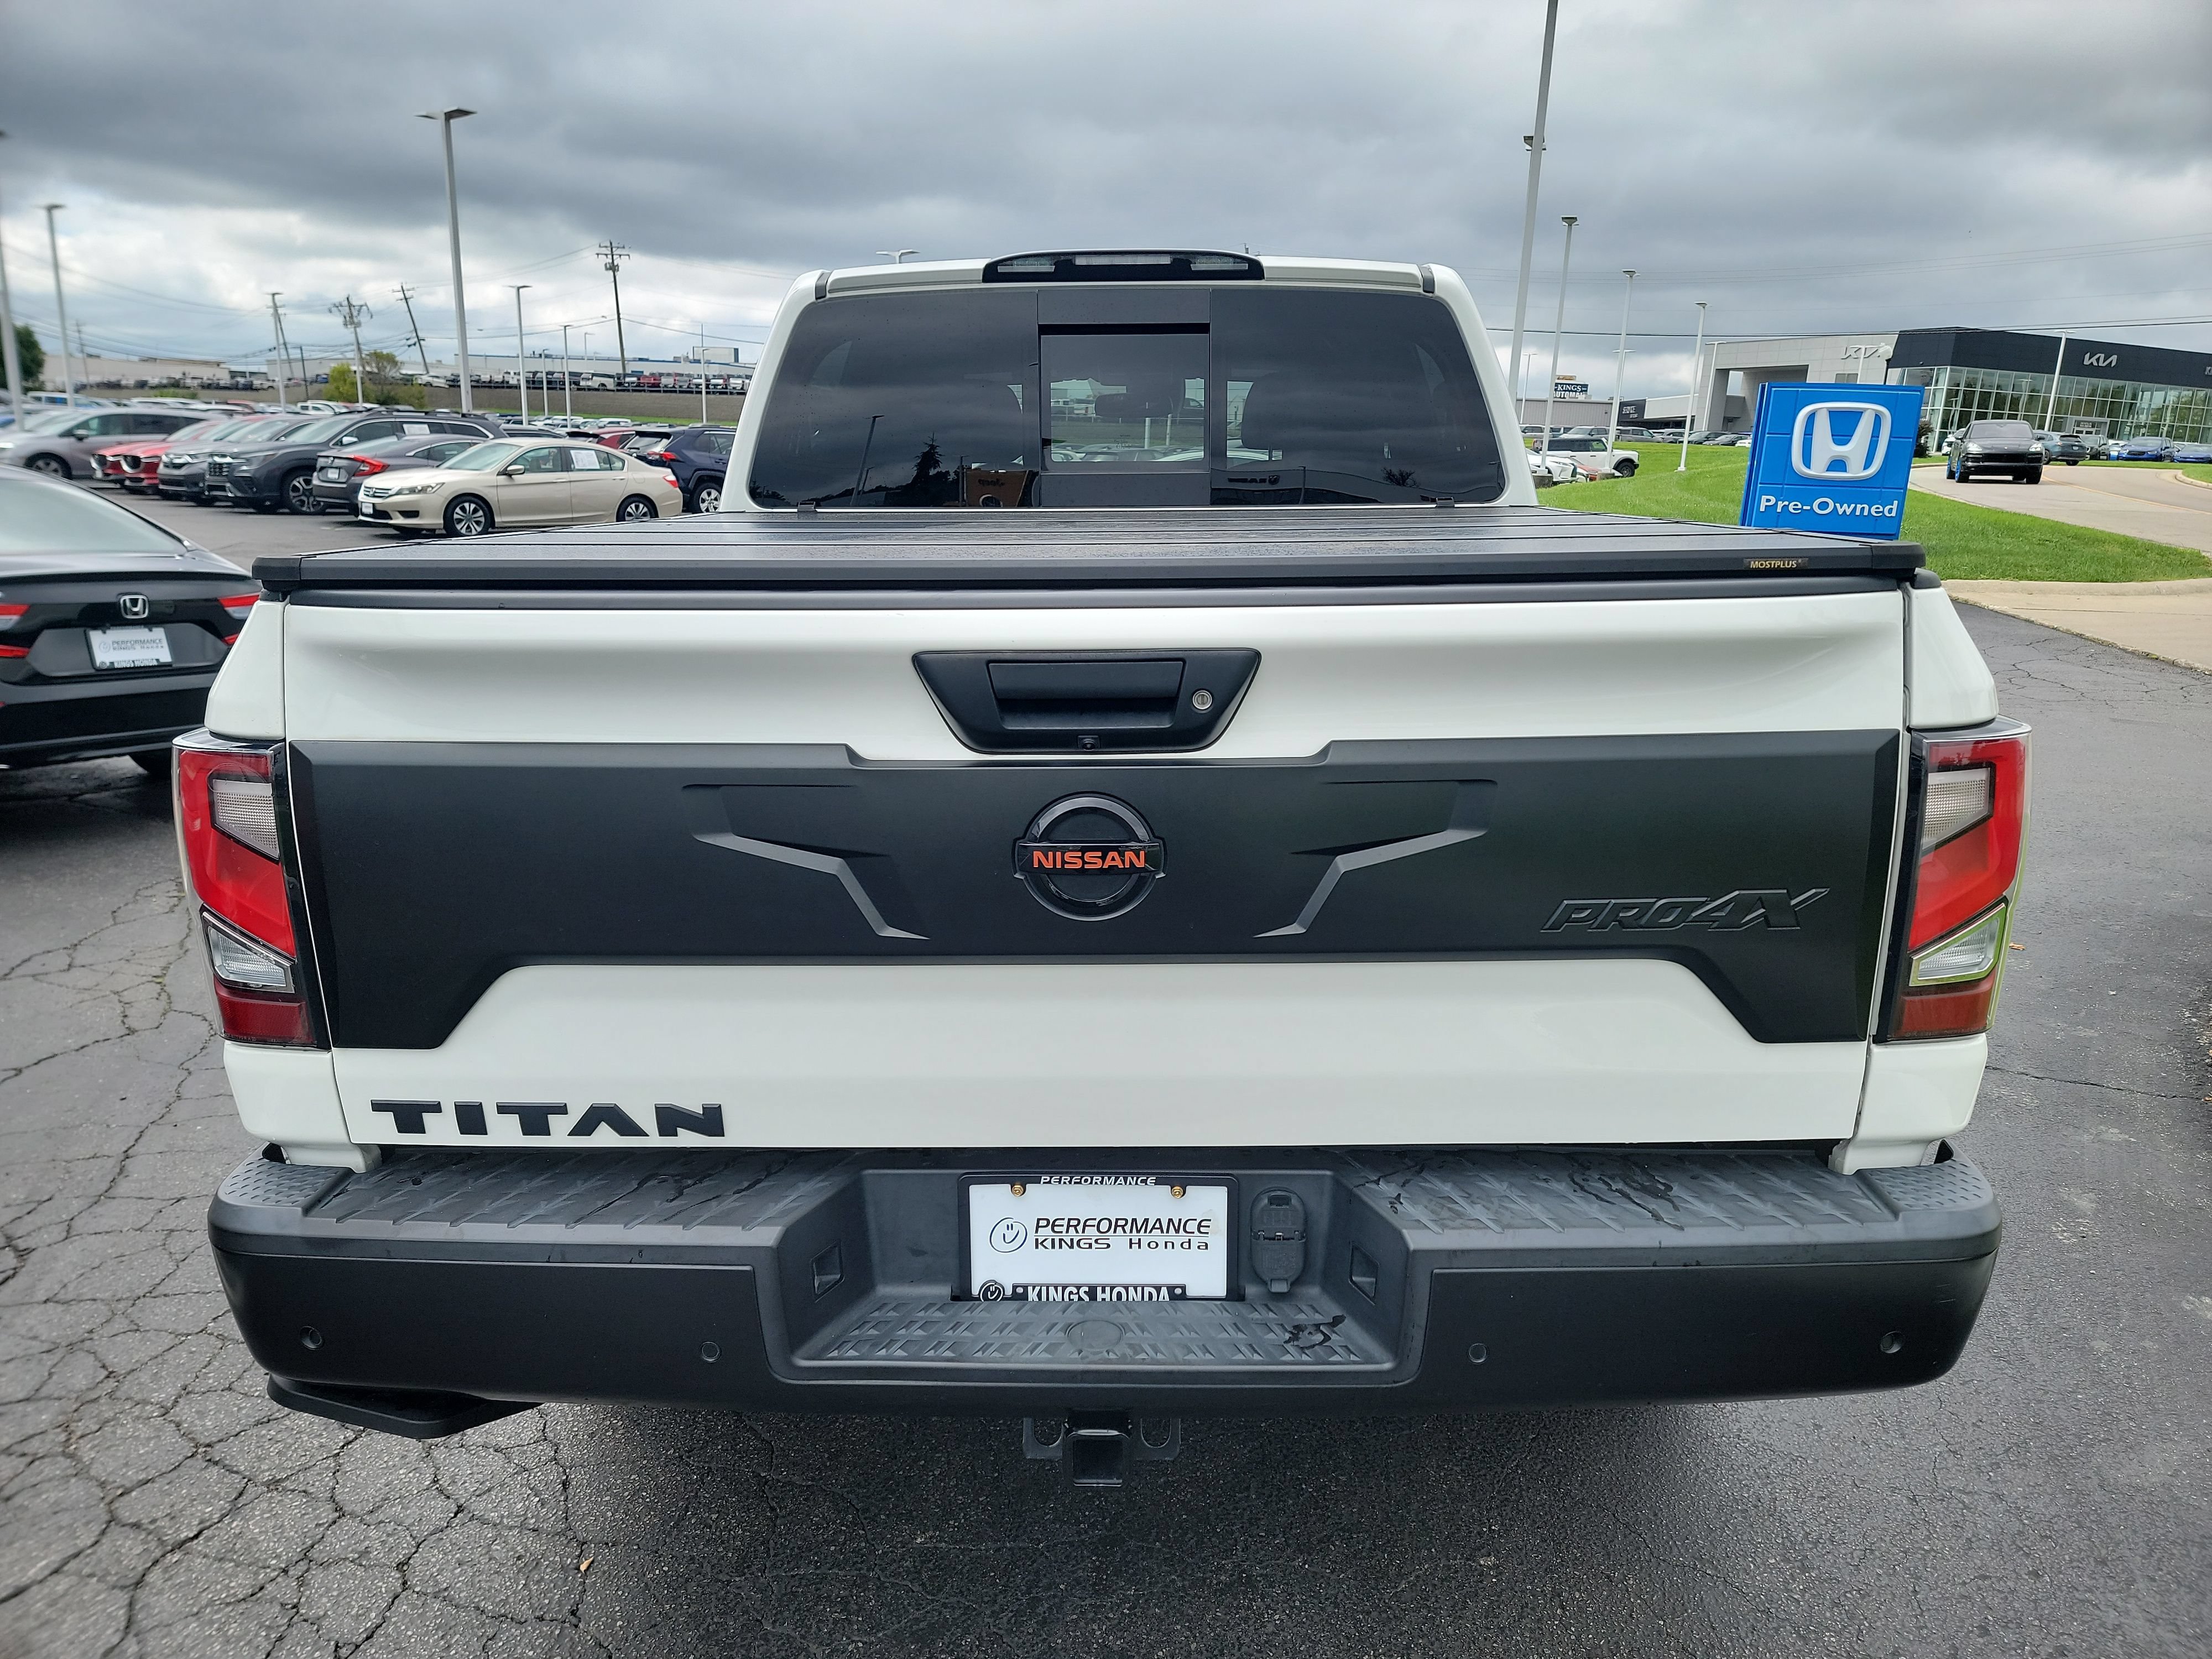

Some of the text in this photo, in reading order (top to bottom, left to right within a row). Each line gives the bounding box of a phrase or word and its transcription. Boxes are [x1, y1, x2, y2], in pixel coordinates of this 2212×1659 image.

[2083, 352, 2117, 367] KIA
[1760, 495, 1898, 517] Pre-Owned
[1033, 851, 1145, 869] NISSAN
[370, 1099, 725, 1137] TITAN
[1040, 1176, 1156, 1186] PERFORMANCE
[1035, 1218, 1212, 1234] PERFORMANCE
[1035, 1238, 1209, 1250] KINGS Honda
[1027, 1286, 1170, 1301] KINGS HONDA
